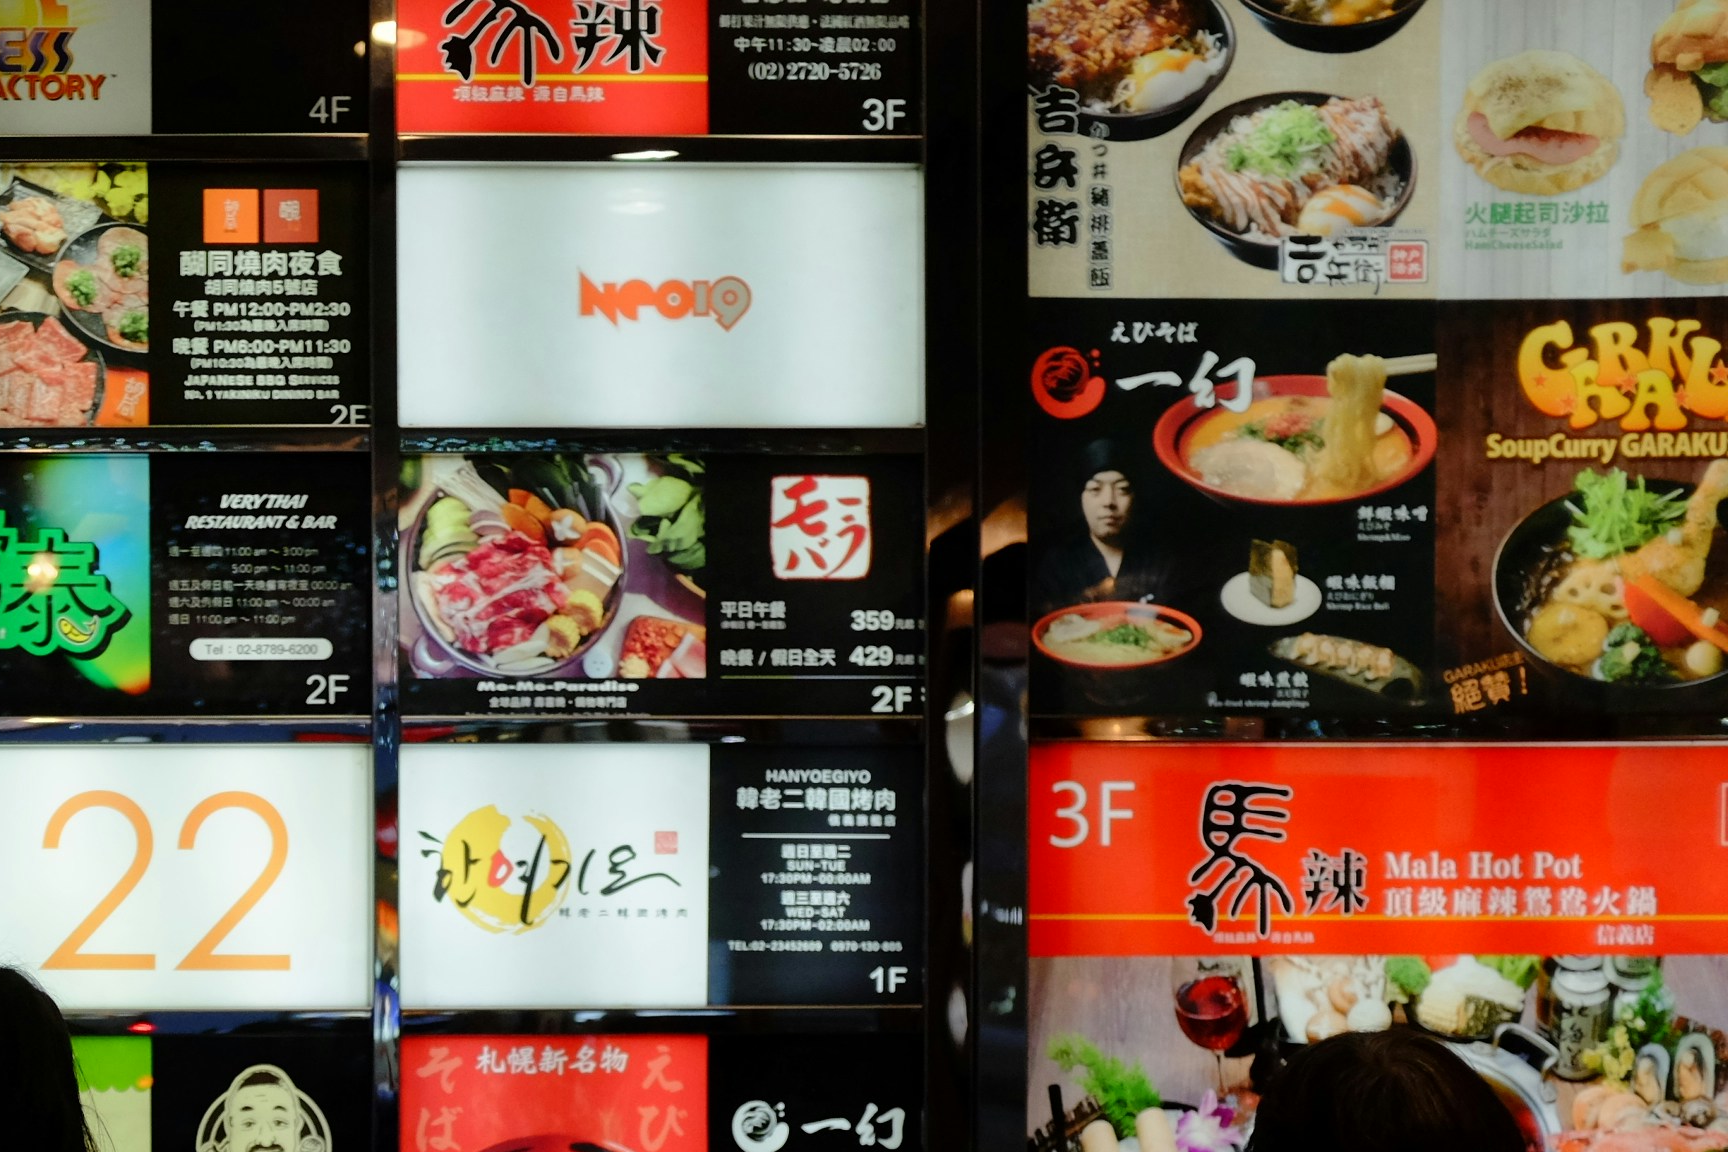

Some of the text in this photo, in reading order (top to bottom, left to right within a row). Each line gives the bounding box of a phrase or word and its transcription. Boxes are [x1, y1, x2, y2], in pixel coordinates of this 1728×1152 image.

[308, 96, 351, 124] 4F
[862, 98, 907, 131] 3F
[1034, 87, 1080, 246] 吉兵衛
[1464, 201, 1610, 226] 火腿起司沙拉
[212, 302, 352, 317] PM12:00-PM2:30
[212, 339, 352, 354] PM6:00-PM11:30
[1110, 320, 1199, 345] えびそば
[1114, 350, 1258, 415] 一幻
[329, 404, 368, 425] 2F
[1486, 432, 1618, 464] SoupCurry
[184, 515, 287, 529] RESTAURANT
[301, 515, 338, 529] BAR
[850, 609, 896, 631] 359
[848, 645, 894, 666] 429
[305, 674, 351, 704] 2F
[871, 685, 913, 713] 2F
[765, 769, 872, 784] HANYOEGIYO
[736, 786, 897, 811] 韓老二韓國烤肉
[1048, 780, 1137, 849] 3F
[786, 859, 847, 872] SUN-TUE
[1384, 850, 1584, 880] Mala Hot Pot
[38, 789, 291, 972] 22
[784, 906, 847, 919] WED-SAT
[1383, 885, 1658, 918] 頂級麻辣鴛鴦火鍋
[1595, 923, 1656, 946] 信義店
[869, 965, 909, 994] 1F
[475, 1044, 630, 1076] 札幌新名物
[800, 1102, 907, 1150] 一幻
